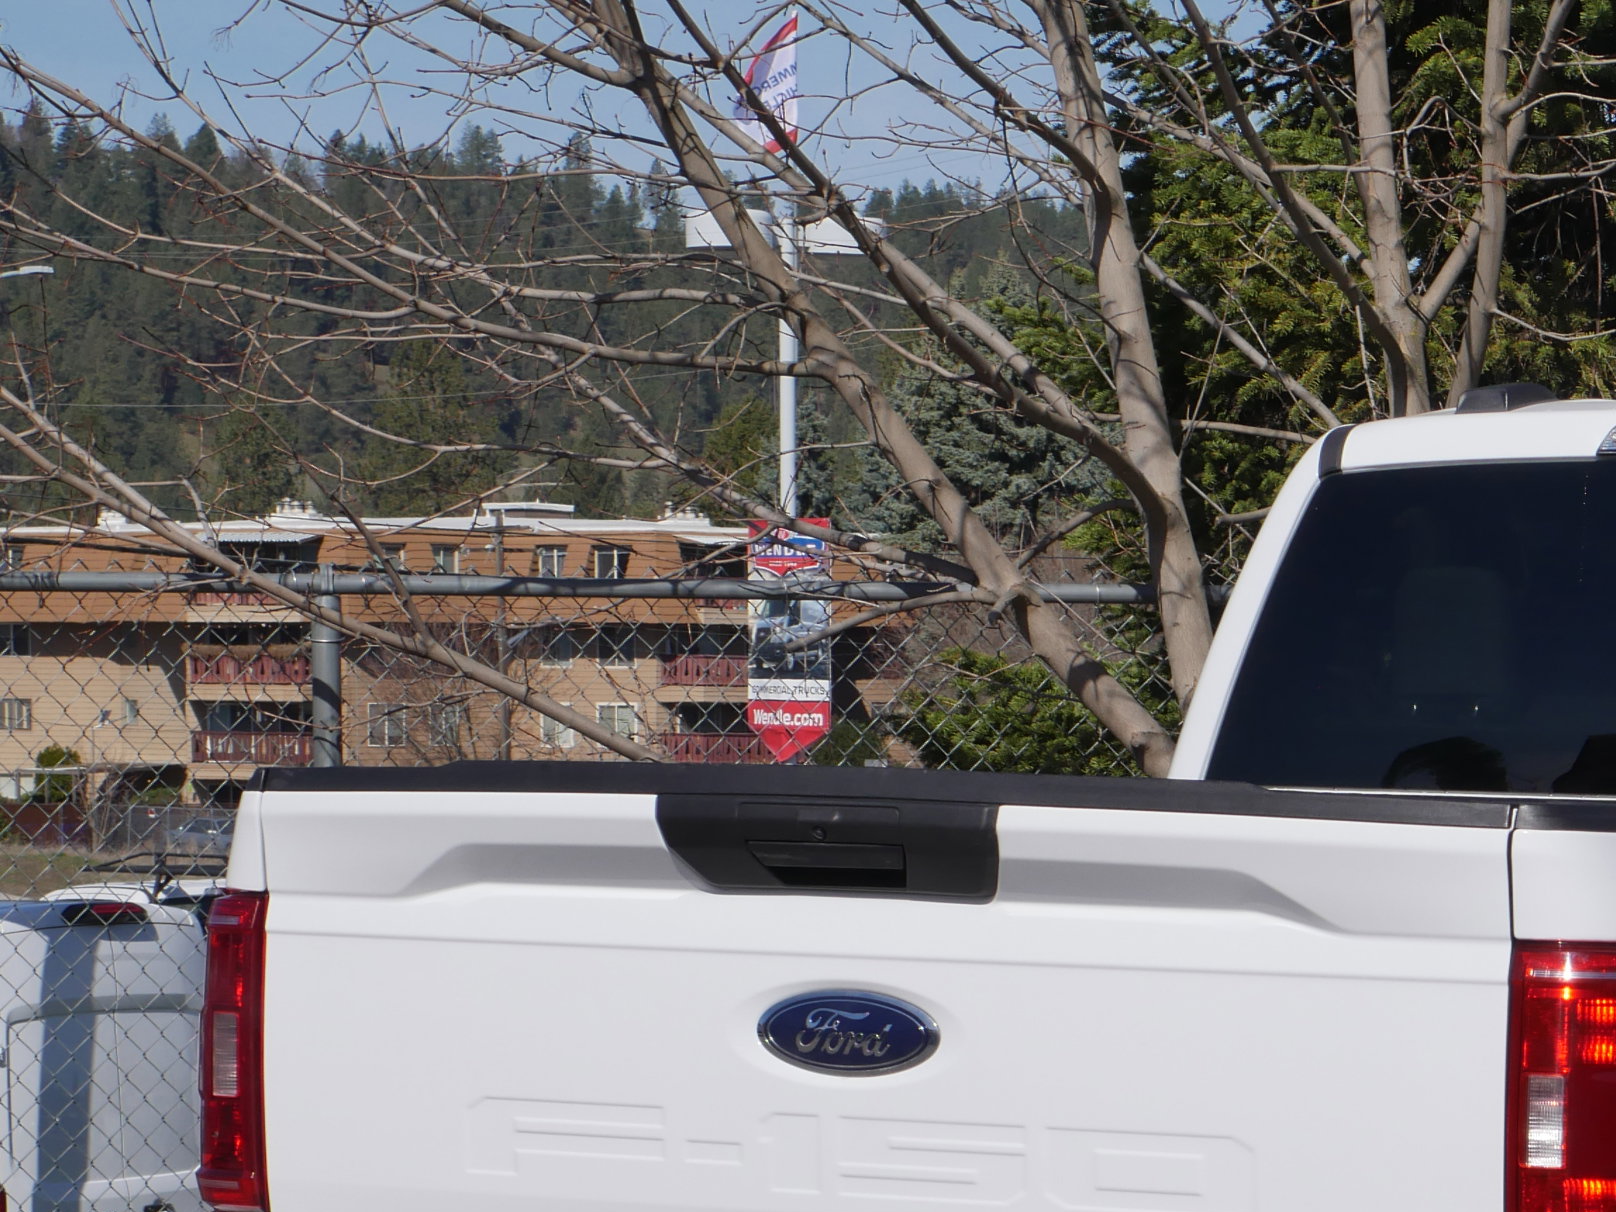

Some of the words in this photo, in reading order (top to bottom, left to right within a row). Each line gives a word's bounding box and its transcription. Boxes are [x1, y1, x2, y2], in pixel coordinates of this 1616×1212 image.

[793, 686, 825, 695] TRUCKS
[753, 708, 823, 726] Wendle.com
[795, 1008, 893, 1057] Ford
